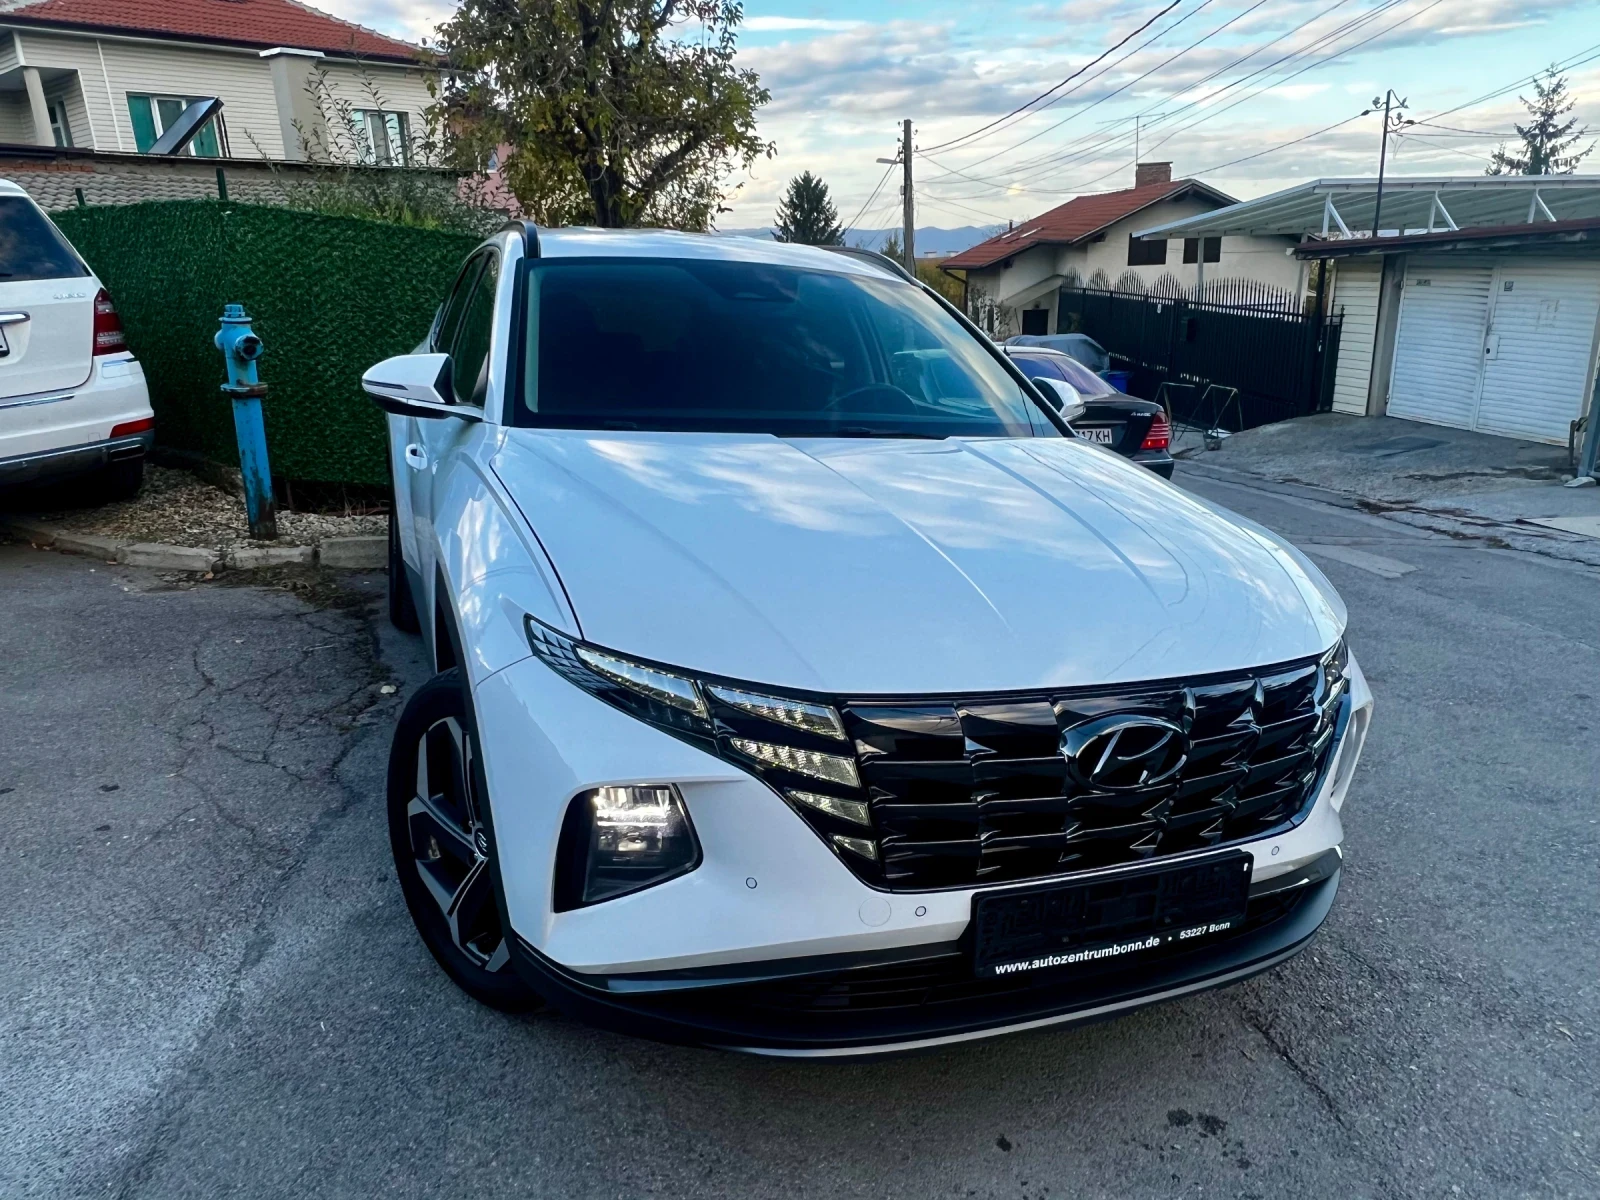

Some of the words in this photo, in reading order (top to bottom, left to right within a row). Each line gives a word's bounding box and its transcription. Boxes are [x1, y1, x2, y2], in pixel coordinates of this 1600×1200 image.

[995, 936, 1160, 975] www.autozentrumbonn.de
[1179, 925, 1208, 940] 53227
[1208, 921, 1231, 933] Bonn
